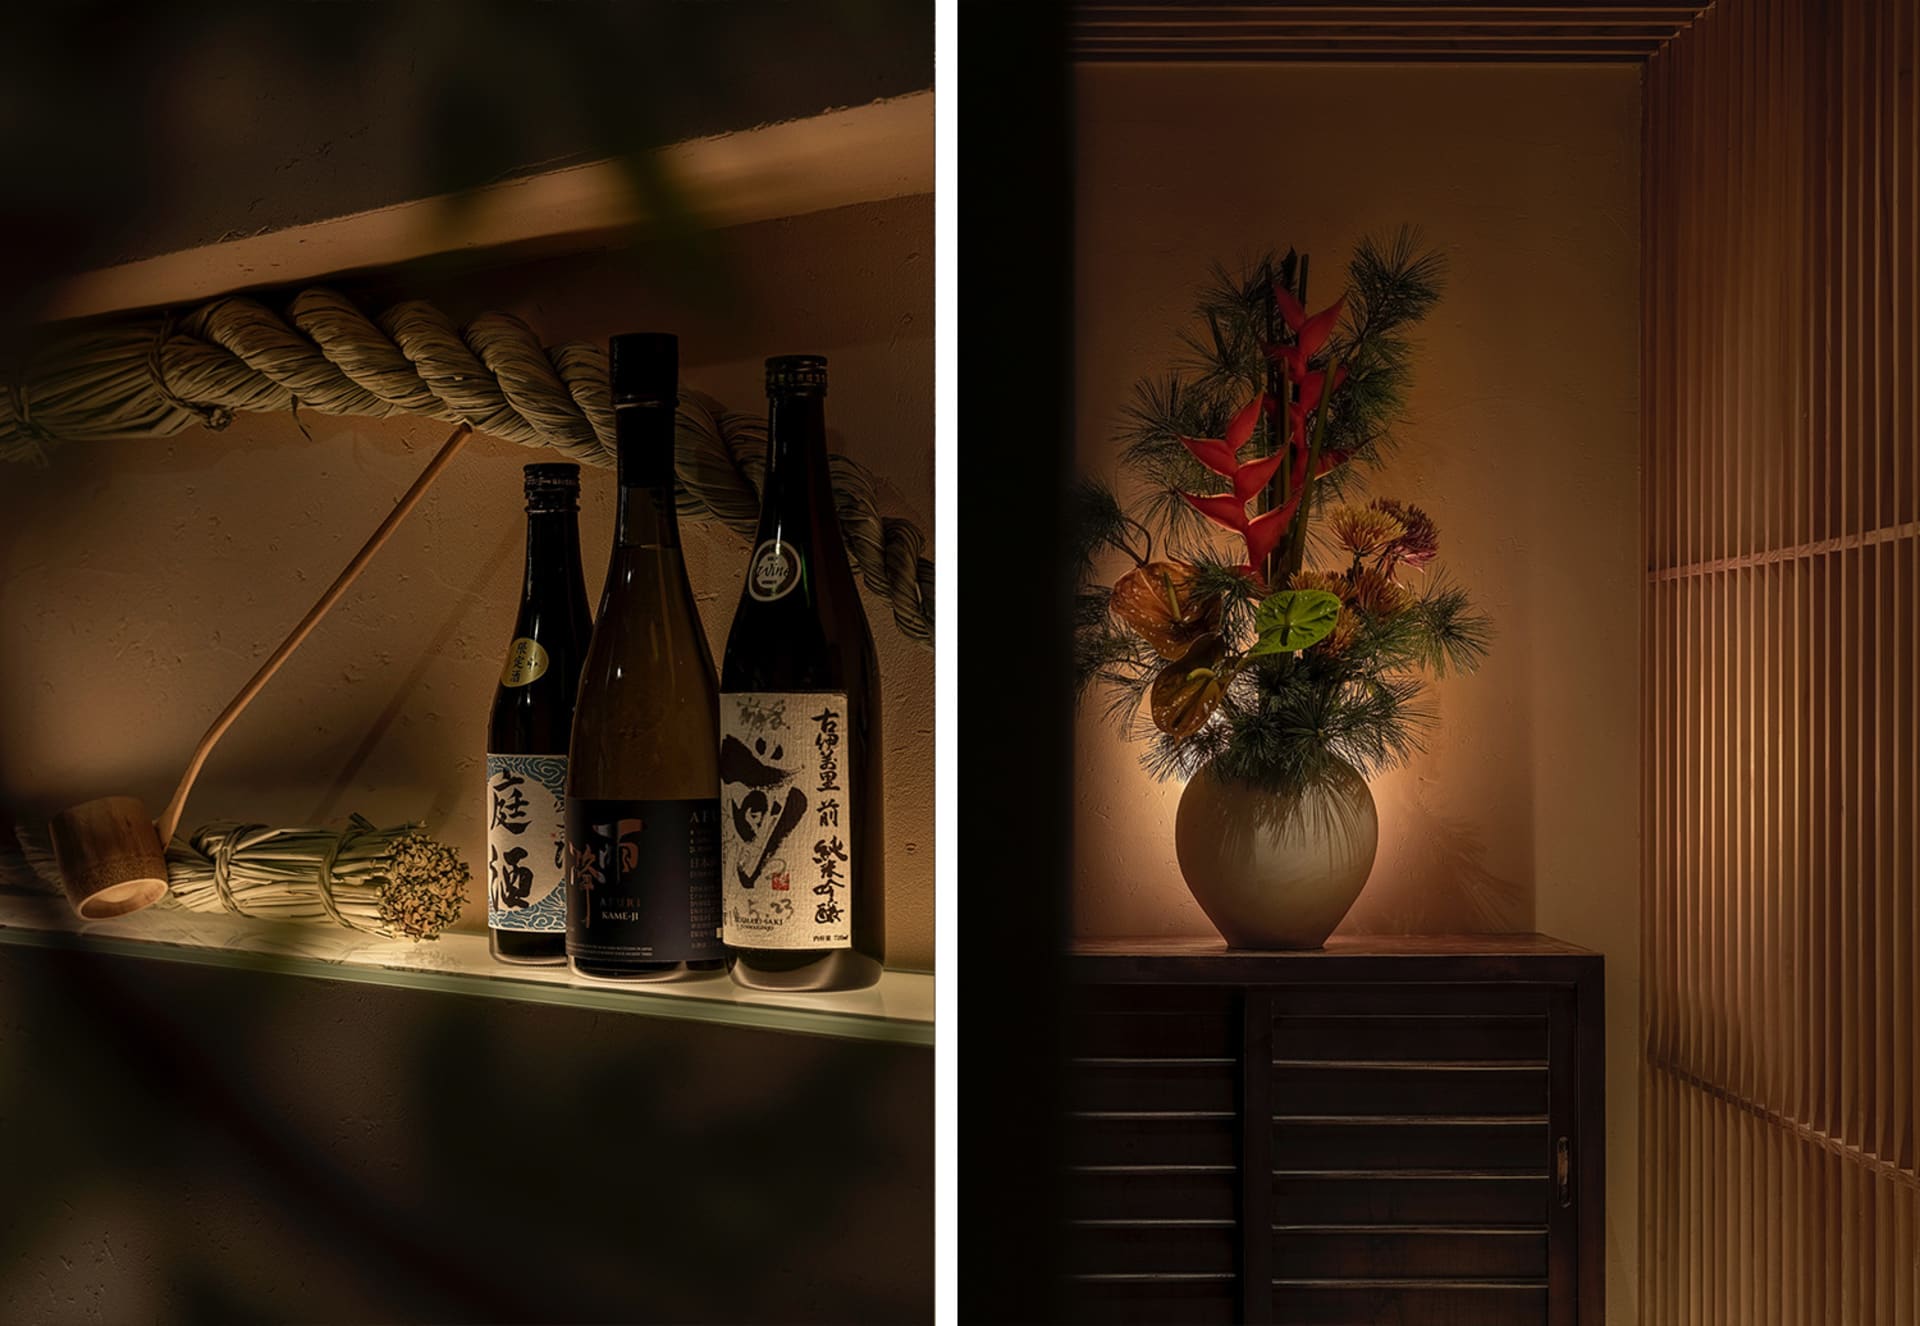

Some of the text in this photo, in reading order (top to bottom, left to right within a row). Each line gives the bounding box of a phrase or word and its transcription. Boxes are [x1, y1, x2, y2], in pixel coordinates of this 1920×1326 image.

[818, 799, 839, 826] 前
[490, 769, 533, 912] 庭酒
[601, 911, 640, 921] KAME-JI
